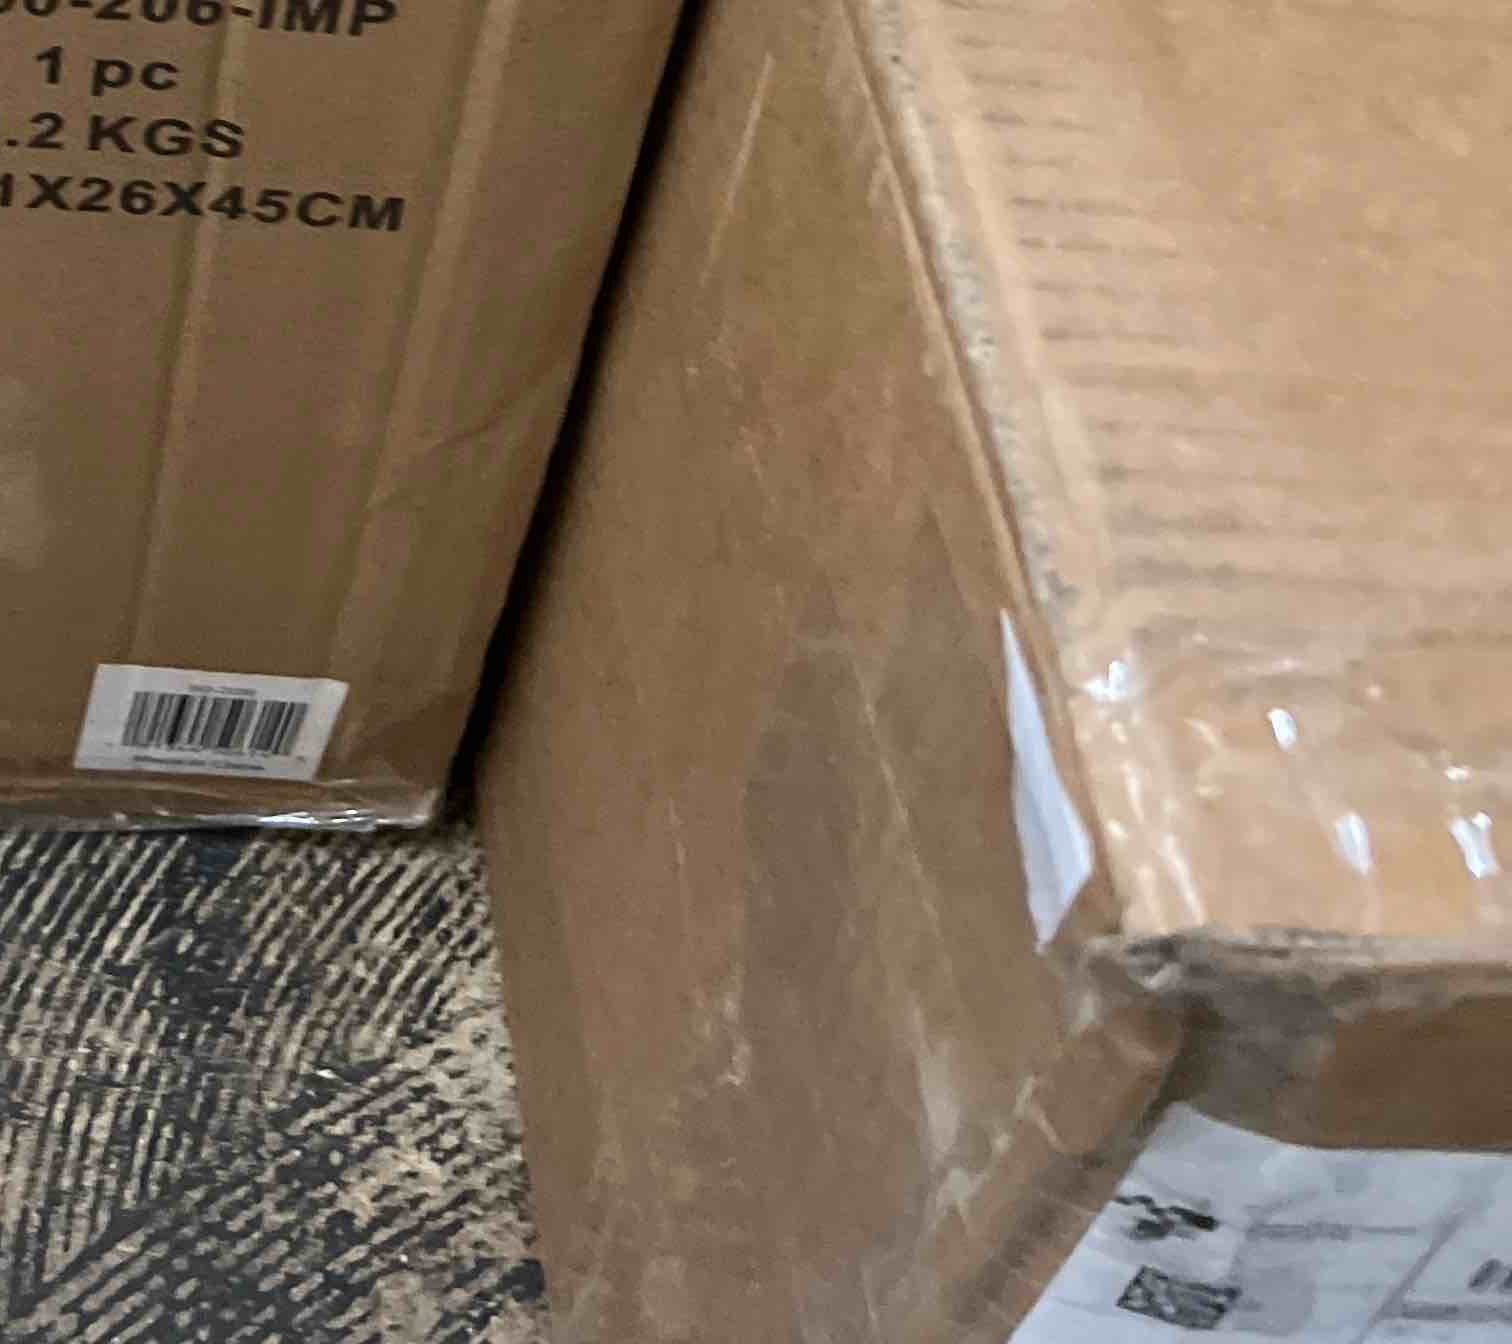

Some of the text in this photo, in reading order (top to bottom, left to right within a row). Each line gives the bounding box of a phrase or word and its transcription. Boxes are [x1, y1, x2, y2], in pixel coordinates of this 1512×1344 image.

[33, 44, 64, 85] 1
[90, 56, 180, 97] pc
[87, 113, 246, 159] KGS
